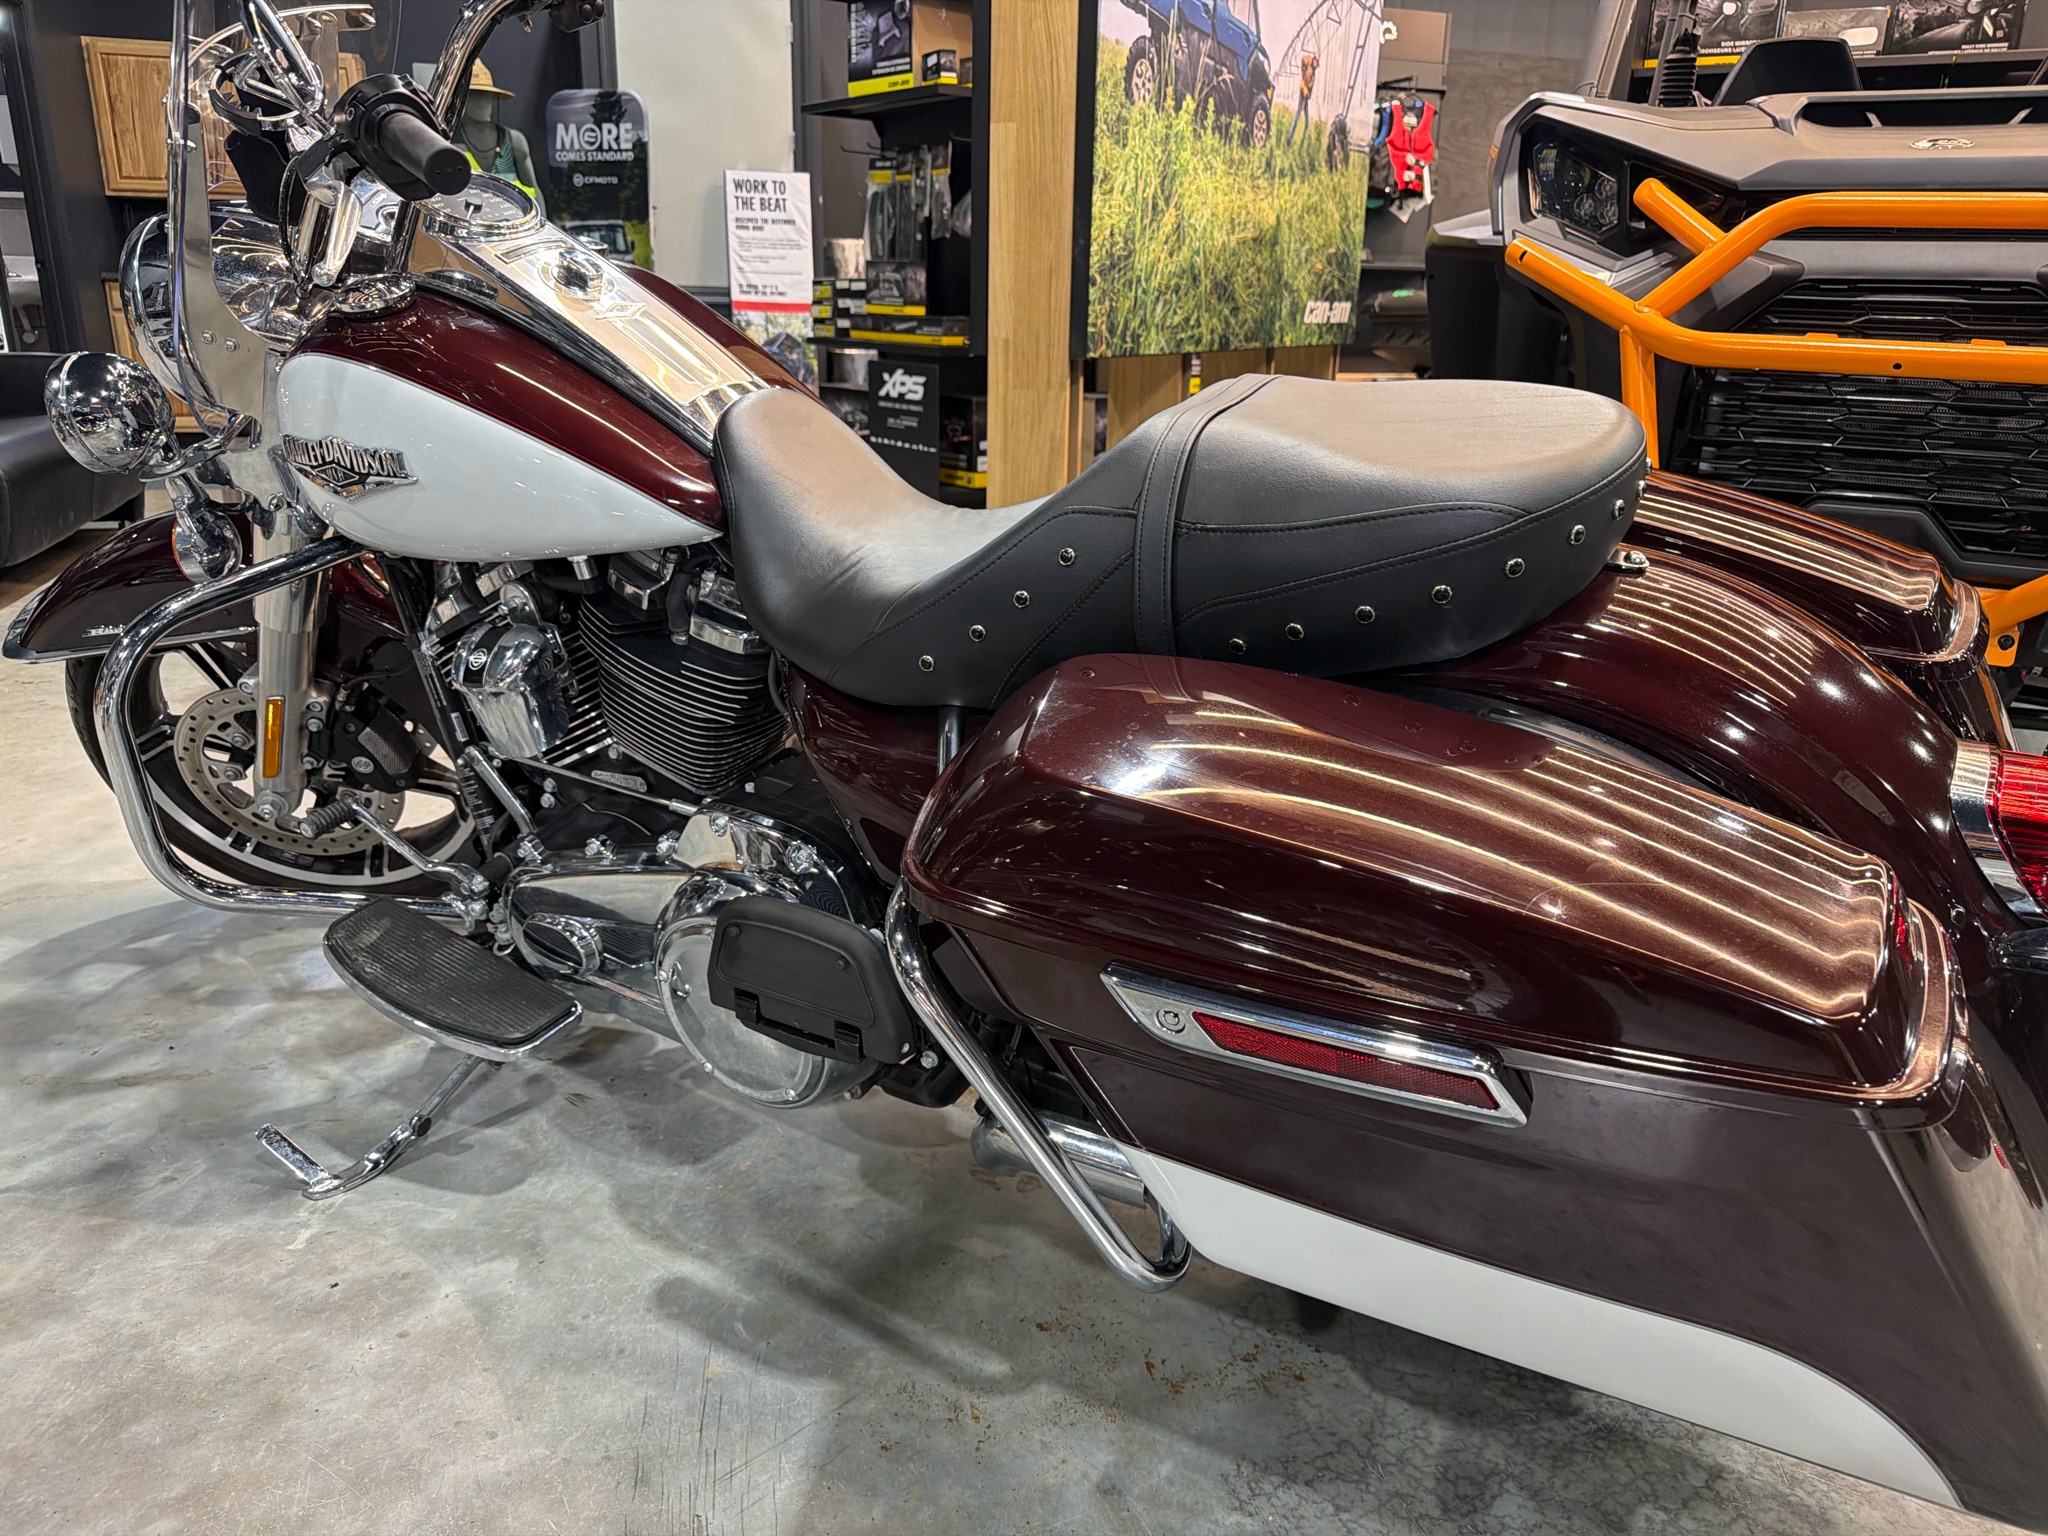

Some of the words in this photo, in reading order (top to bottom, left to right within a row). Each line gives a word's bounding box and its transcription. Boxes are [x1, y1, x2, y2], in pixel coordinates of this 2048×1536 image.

[556, 122, 633, 151] MORE
[556, 151, 586, 161] COMES
[587, 151, 635, 162] STANDARD
[733, 179, 768, 195] WORK
[772, 181, 787, 196] TO
[734, 196, 756, 212] THE
[760, 198, 787, 213] BEAT
[878, 368, 927, 401] XPS
